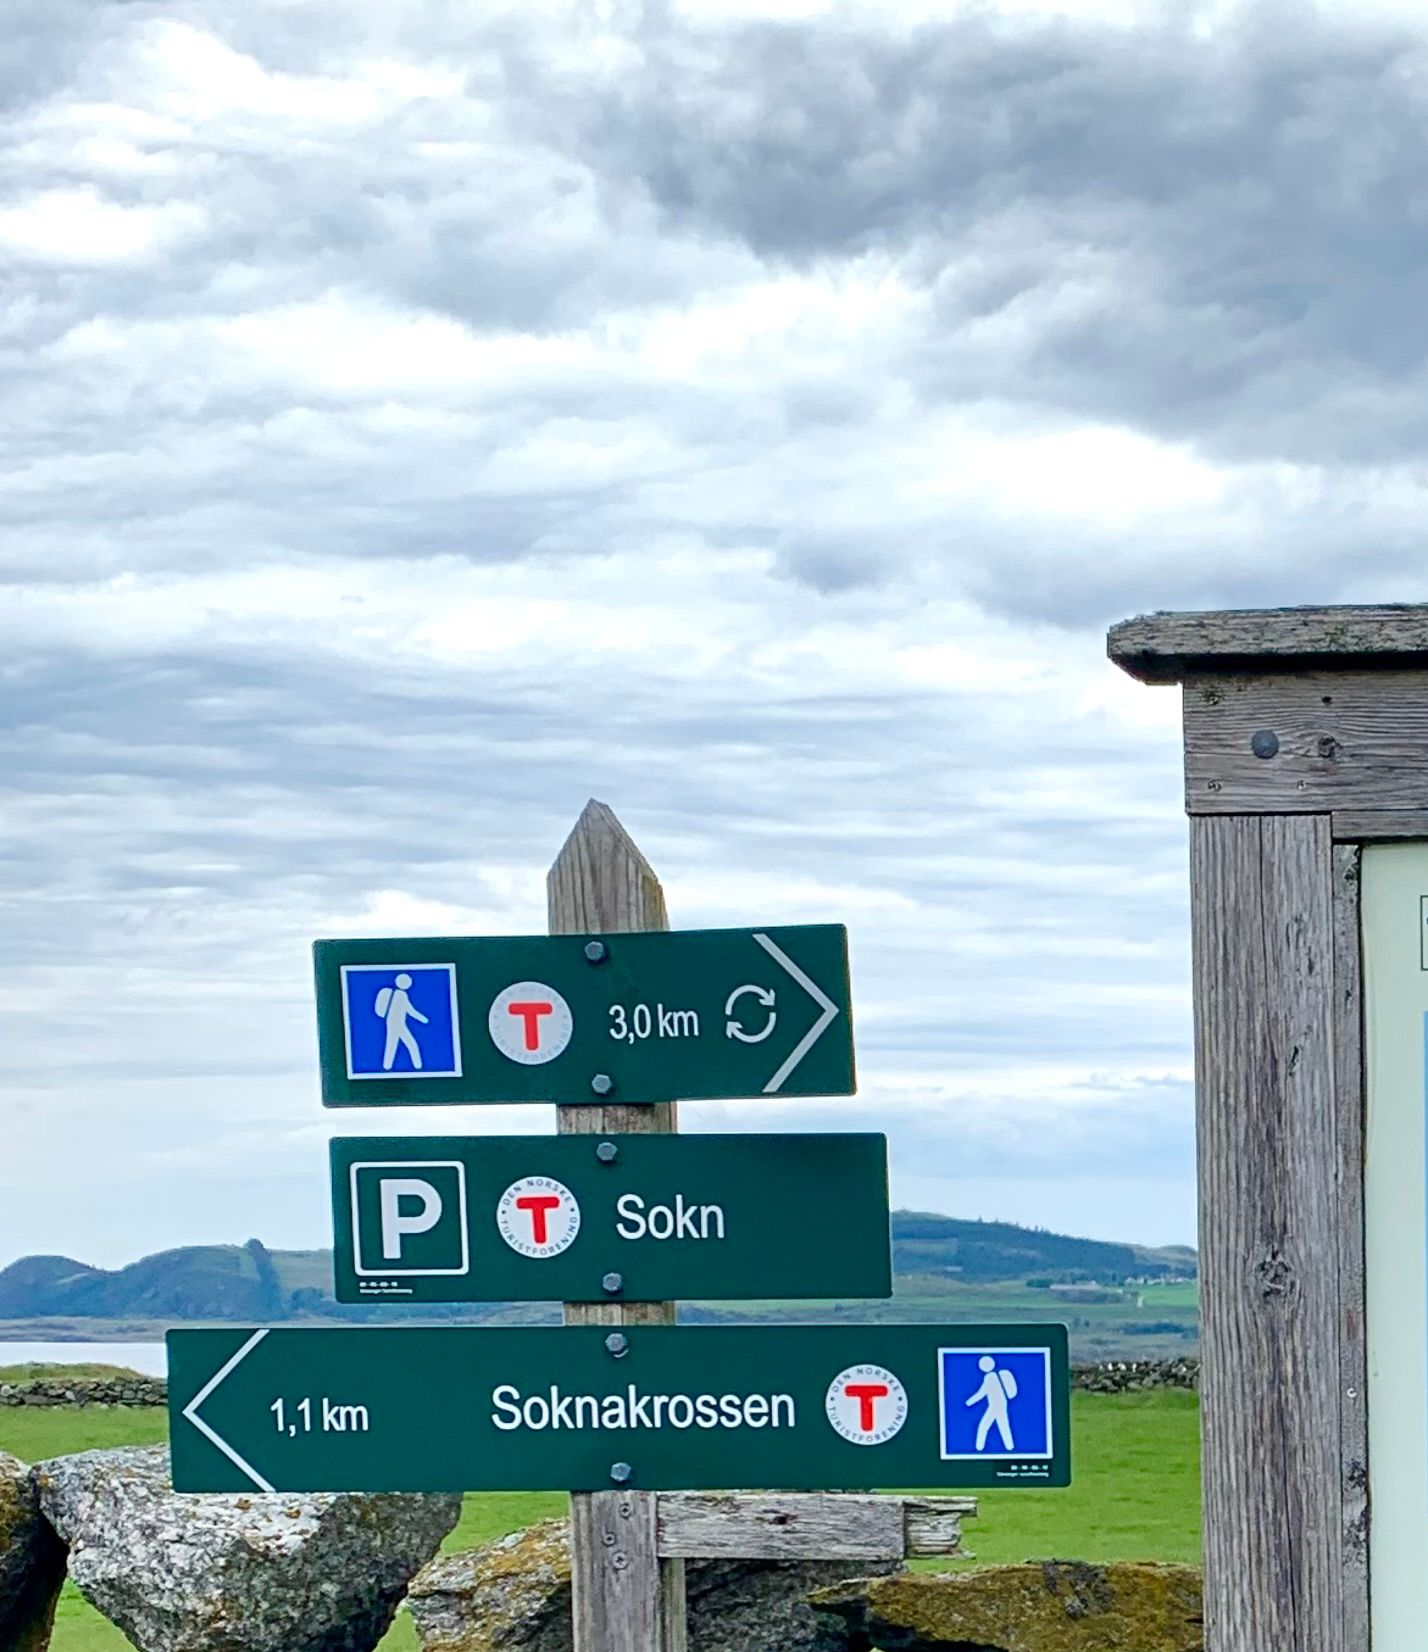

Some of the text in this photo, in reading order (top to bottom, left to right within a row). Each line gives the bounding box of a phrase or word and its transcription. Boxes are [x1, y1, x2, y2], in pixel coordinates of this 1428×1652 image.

[508, 1003, 553, 1051] T
[608, 1003, 651, 1045] 3,0
[657, 1003, 700, 1037] km
[502, 1178, 572, 1206] DEN NORSKE
[379, 1178, 443, 1260] P
[501, 1216, 578, 1256] TURISTFORENING
[516, 1196, 561, 1244] T
[616, 1193, 726, 1241] Sokn
[832, 1367, 899, 1393] DEN NORSKE
[270, 1398, 369, 1437] 1,1 km
[491, 1386, 796, 1434] Soknakrossen
[829, 1405, 905, 1443] TURISTFORENING
[844, 1385, 889, 1432] T
